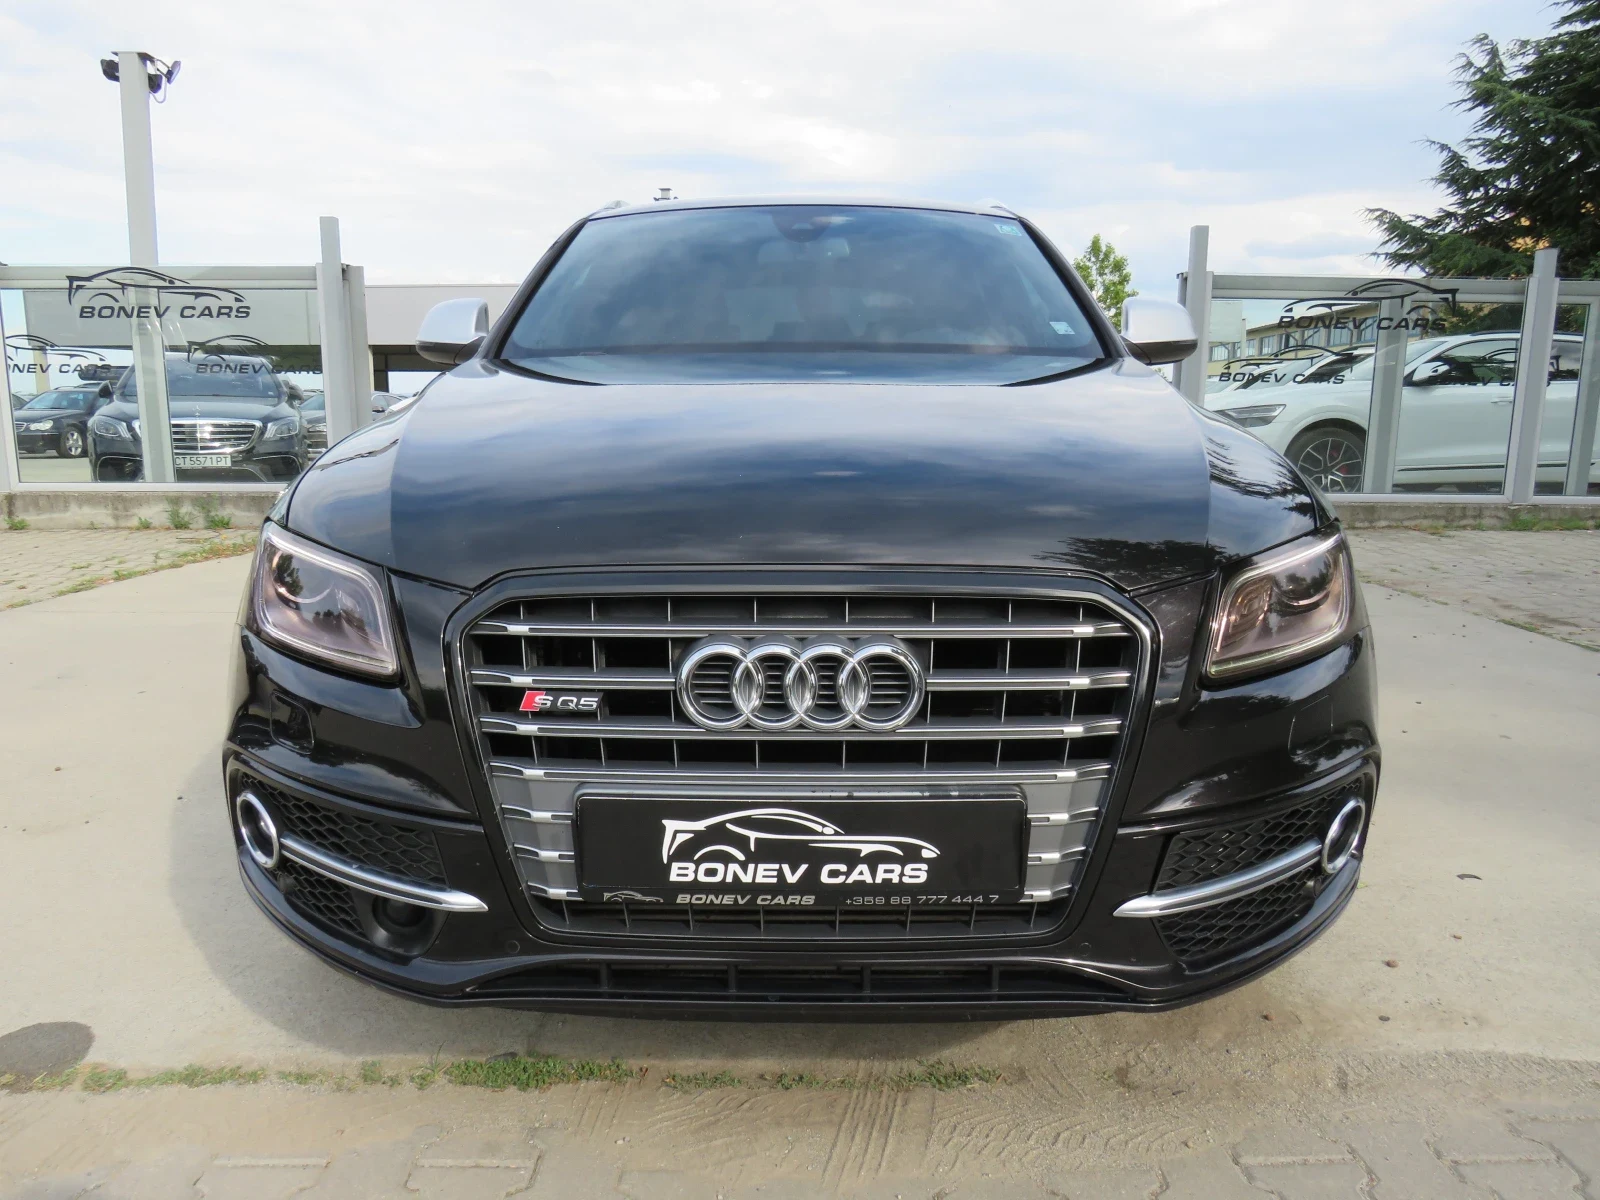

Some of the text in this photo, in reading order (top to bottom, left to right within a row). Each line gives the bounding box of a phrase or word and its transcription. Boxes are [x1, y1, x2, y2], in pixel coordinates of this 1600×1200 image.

[79, 305, 251, 319] BONEV CARS
[1277, 315, 1447, 331] BONEV CARS
[196, 363, 264, 374] BONEV
[669, 862, 928, 884] BONEV CARS
[676, 894, 999, 905] BONEV CARS +359 88 777 444 7
